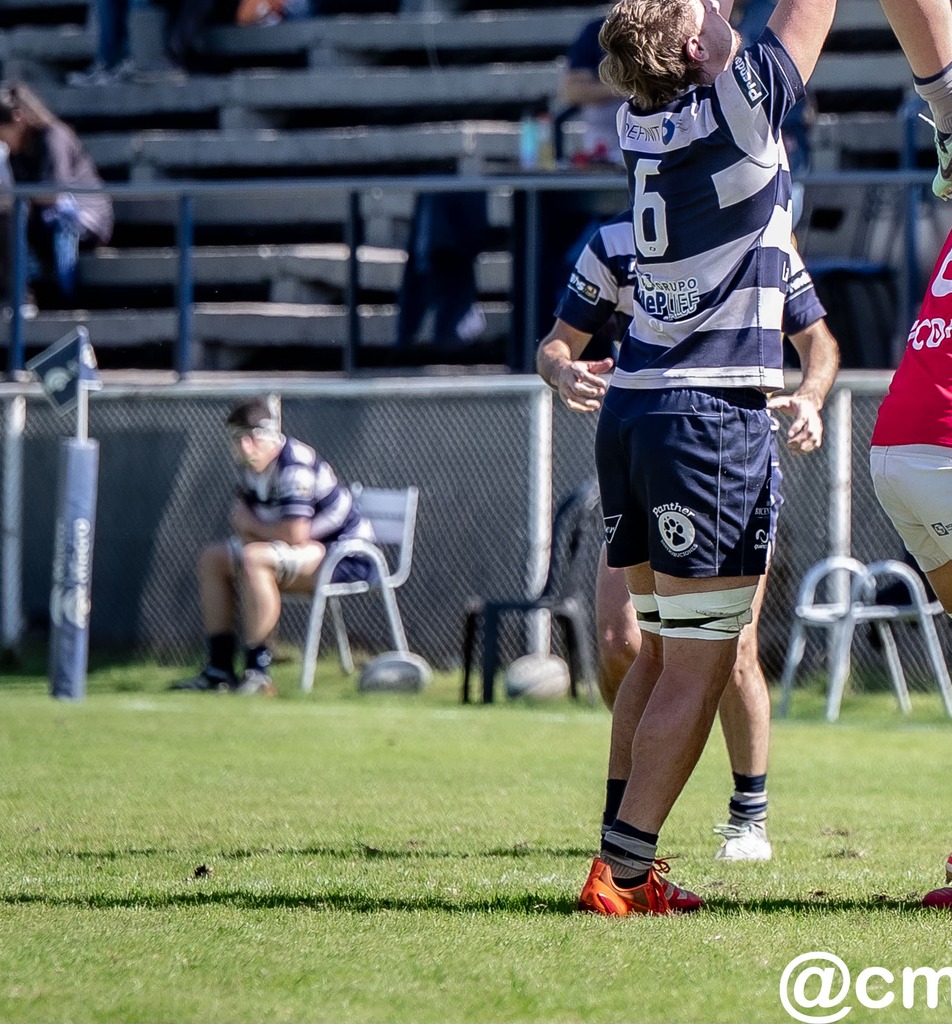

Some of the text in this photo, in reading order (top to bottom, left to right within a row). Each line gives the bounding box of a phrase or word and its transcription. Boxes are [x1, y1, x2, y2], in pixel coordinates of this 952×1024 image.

[633, 158, 669, 258] 6
[655, 278, 697, 292] GRUPO
[652, 502, 696, 518] Panther
